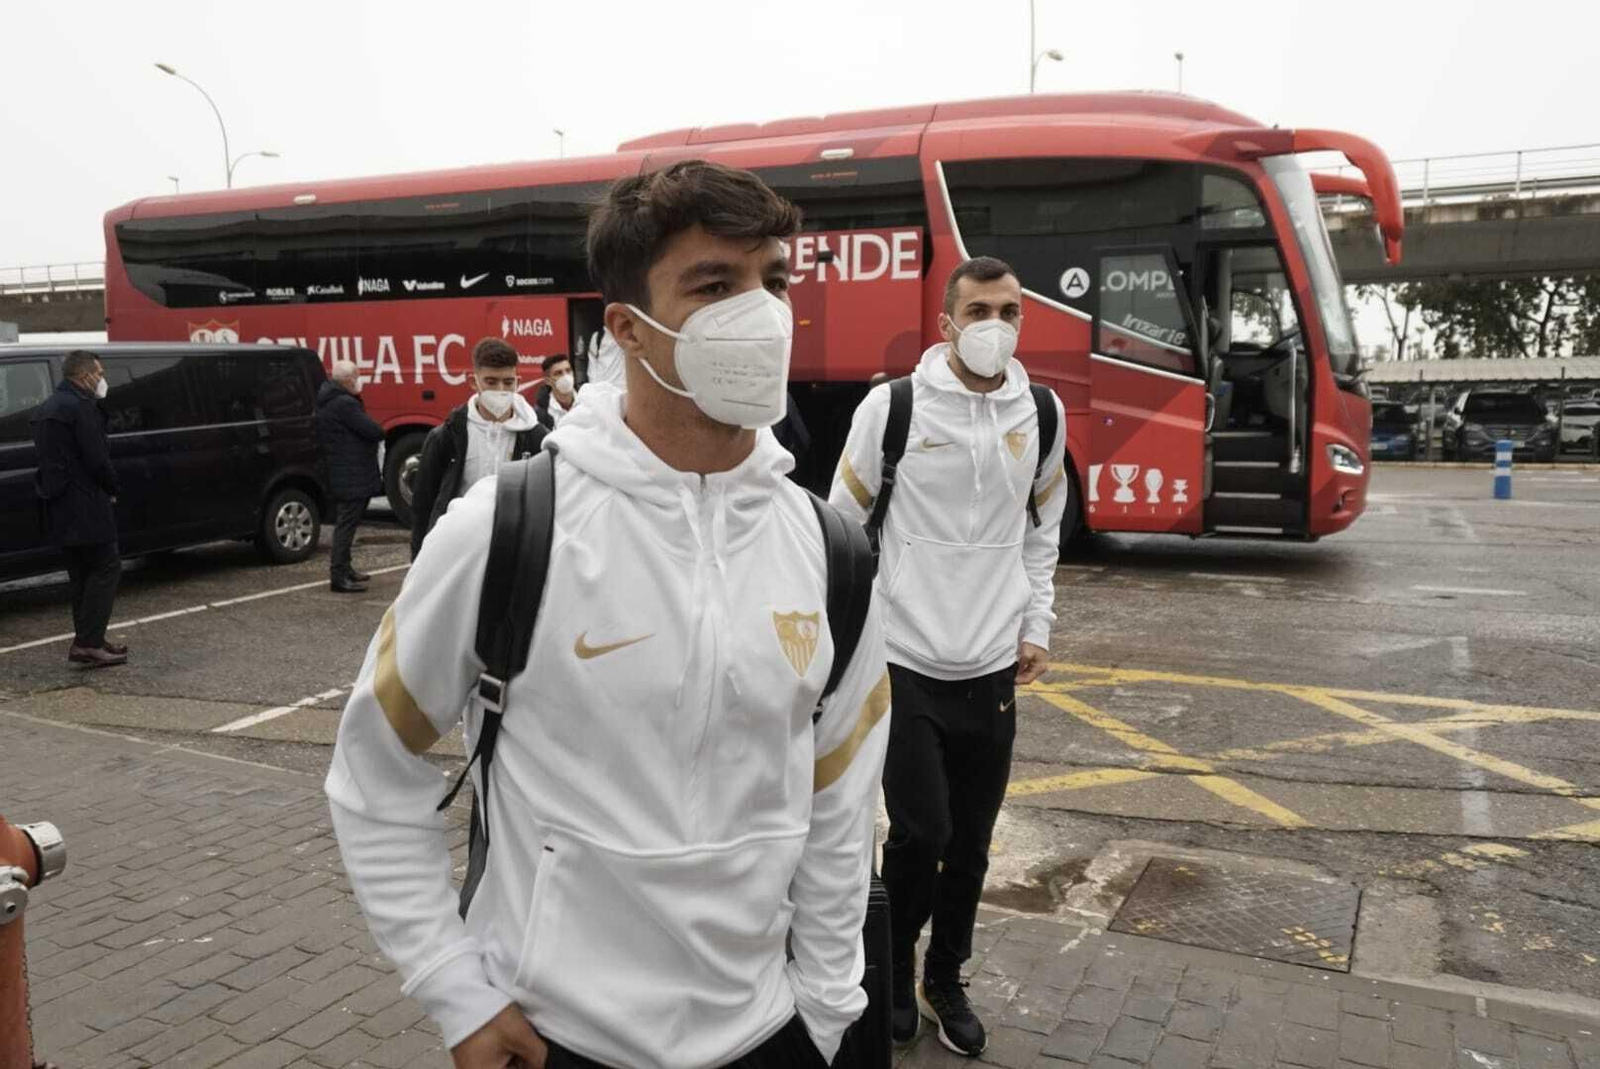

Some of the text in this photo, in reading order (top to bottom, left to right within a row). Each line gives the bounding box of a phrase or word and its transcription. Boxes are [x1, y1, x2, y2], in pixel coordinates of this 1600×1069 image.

[783, 231, 920, 284] ENDE
[364, 279, 391, 292] NAGA
[1100, 270, 1176, 292] OMP
[266, 288, 295, 296] ROBLES
[513, 319, 553, 336] NAGA
[413, 333, 466, 386] FC
